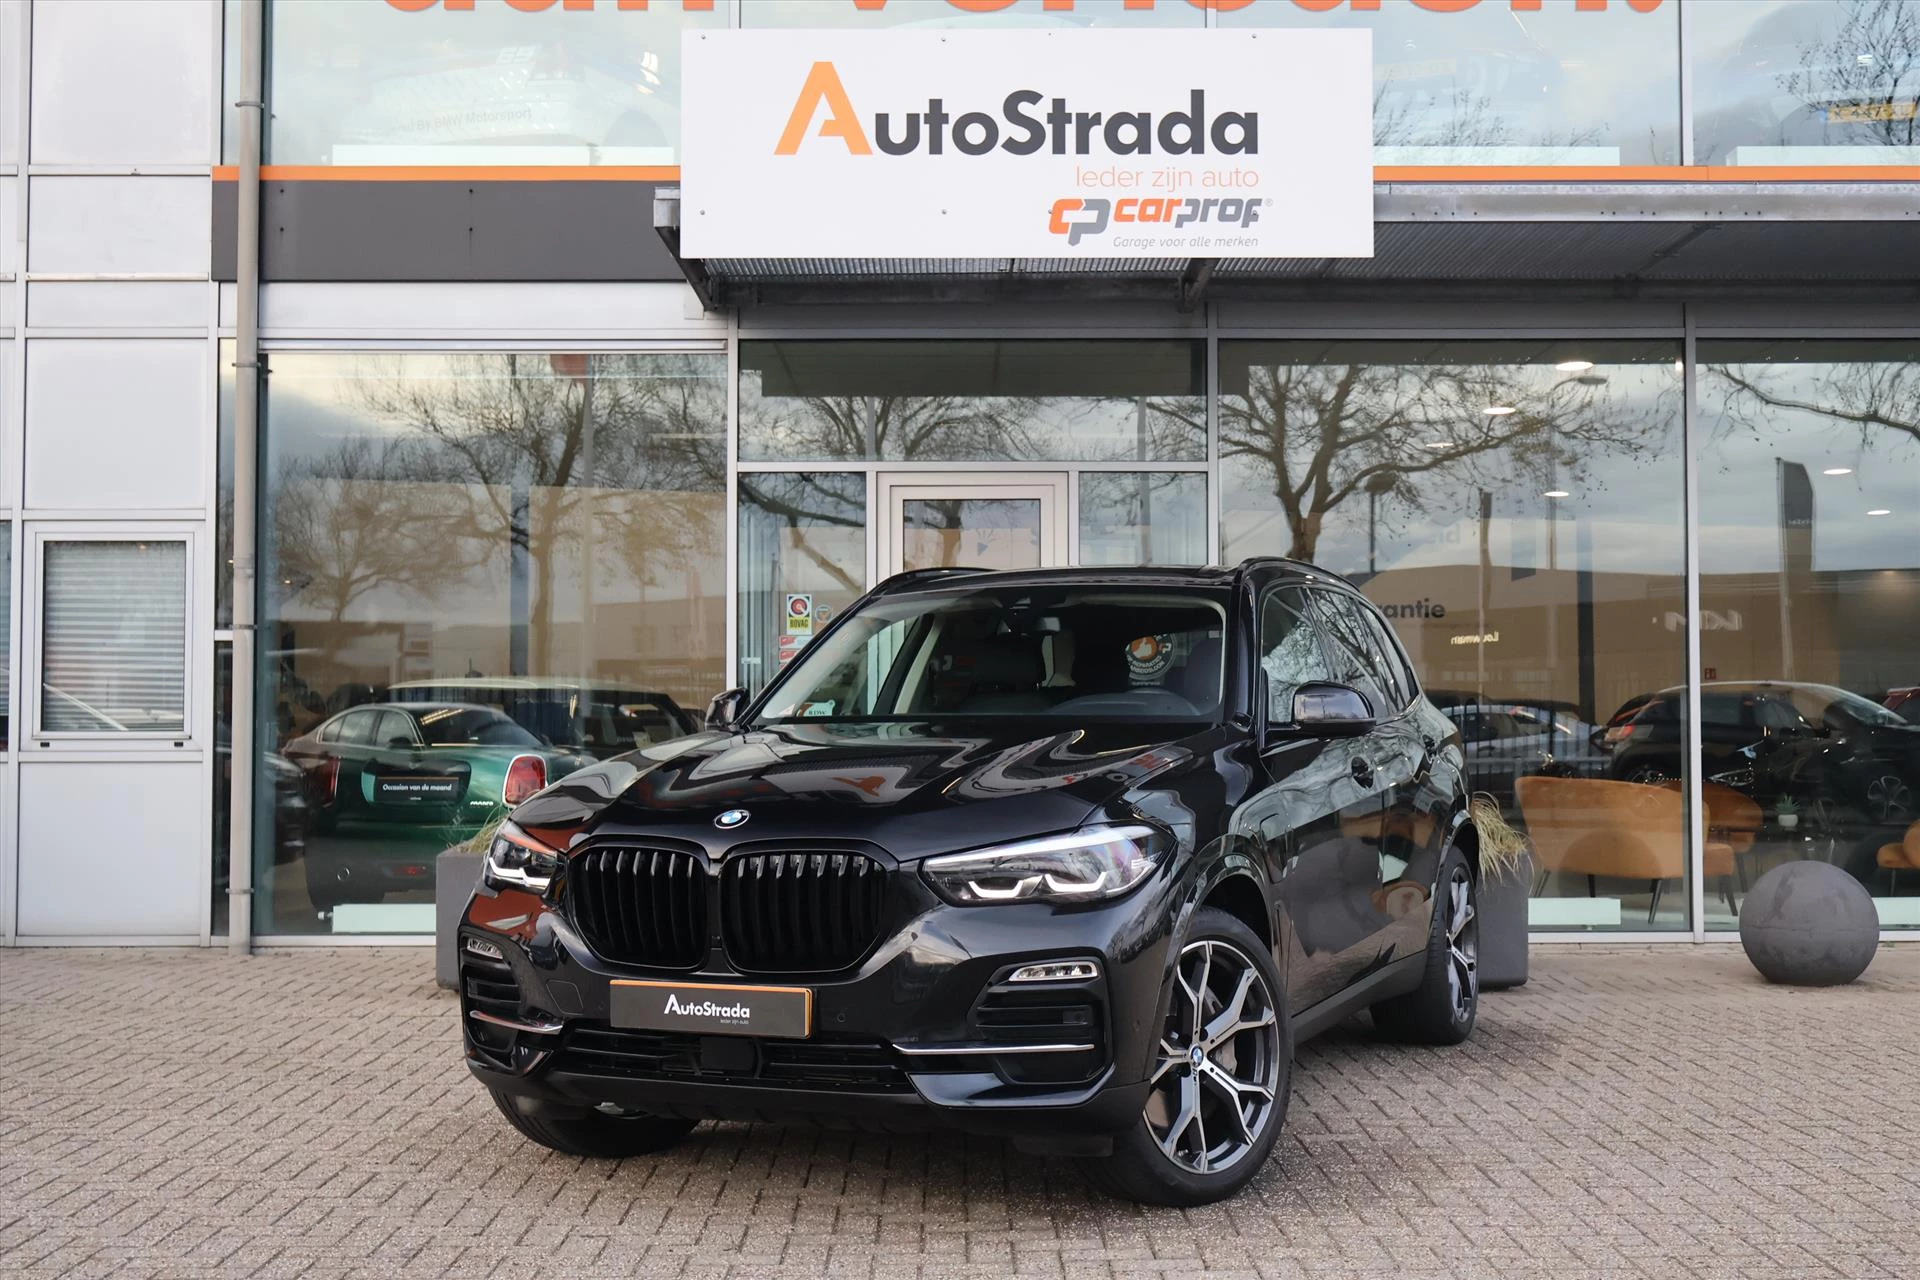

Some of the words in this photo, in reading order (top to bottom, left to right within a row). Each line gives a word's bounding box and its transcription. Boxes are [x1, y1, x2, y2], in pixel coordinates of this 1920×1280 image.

[774, 62, 1258, 156] AutoStrada
[1076, 166, 1143, 188] Ieder
[1151, 166, 1192, 193] zijn
[1201, 168, 1258, 188] auto
[1113, 198, 1262, 228] carprof
[1112, 236, 1156, 250] Garage
[1159, 238, 1185, 248] voor
[1189, 236, 1212, 248] alle
[1215, 236, 1258, 248] merken
[790, 618, 809, 629] BOVAG
[382, 783, 409, 791] Occasion
[421, 783, 429, 791] de
[430, 783, 452, 791] maand
[663, 993, 750, 1018] AutoStrada
